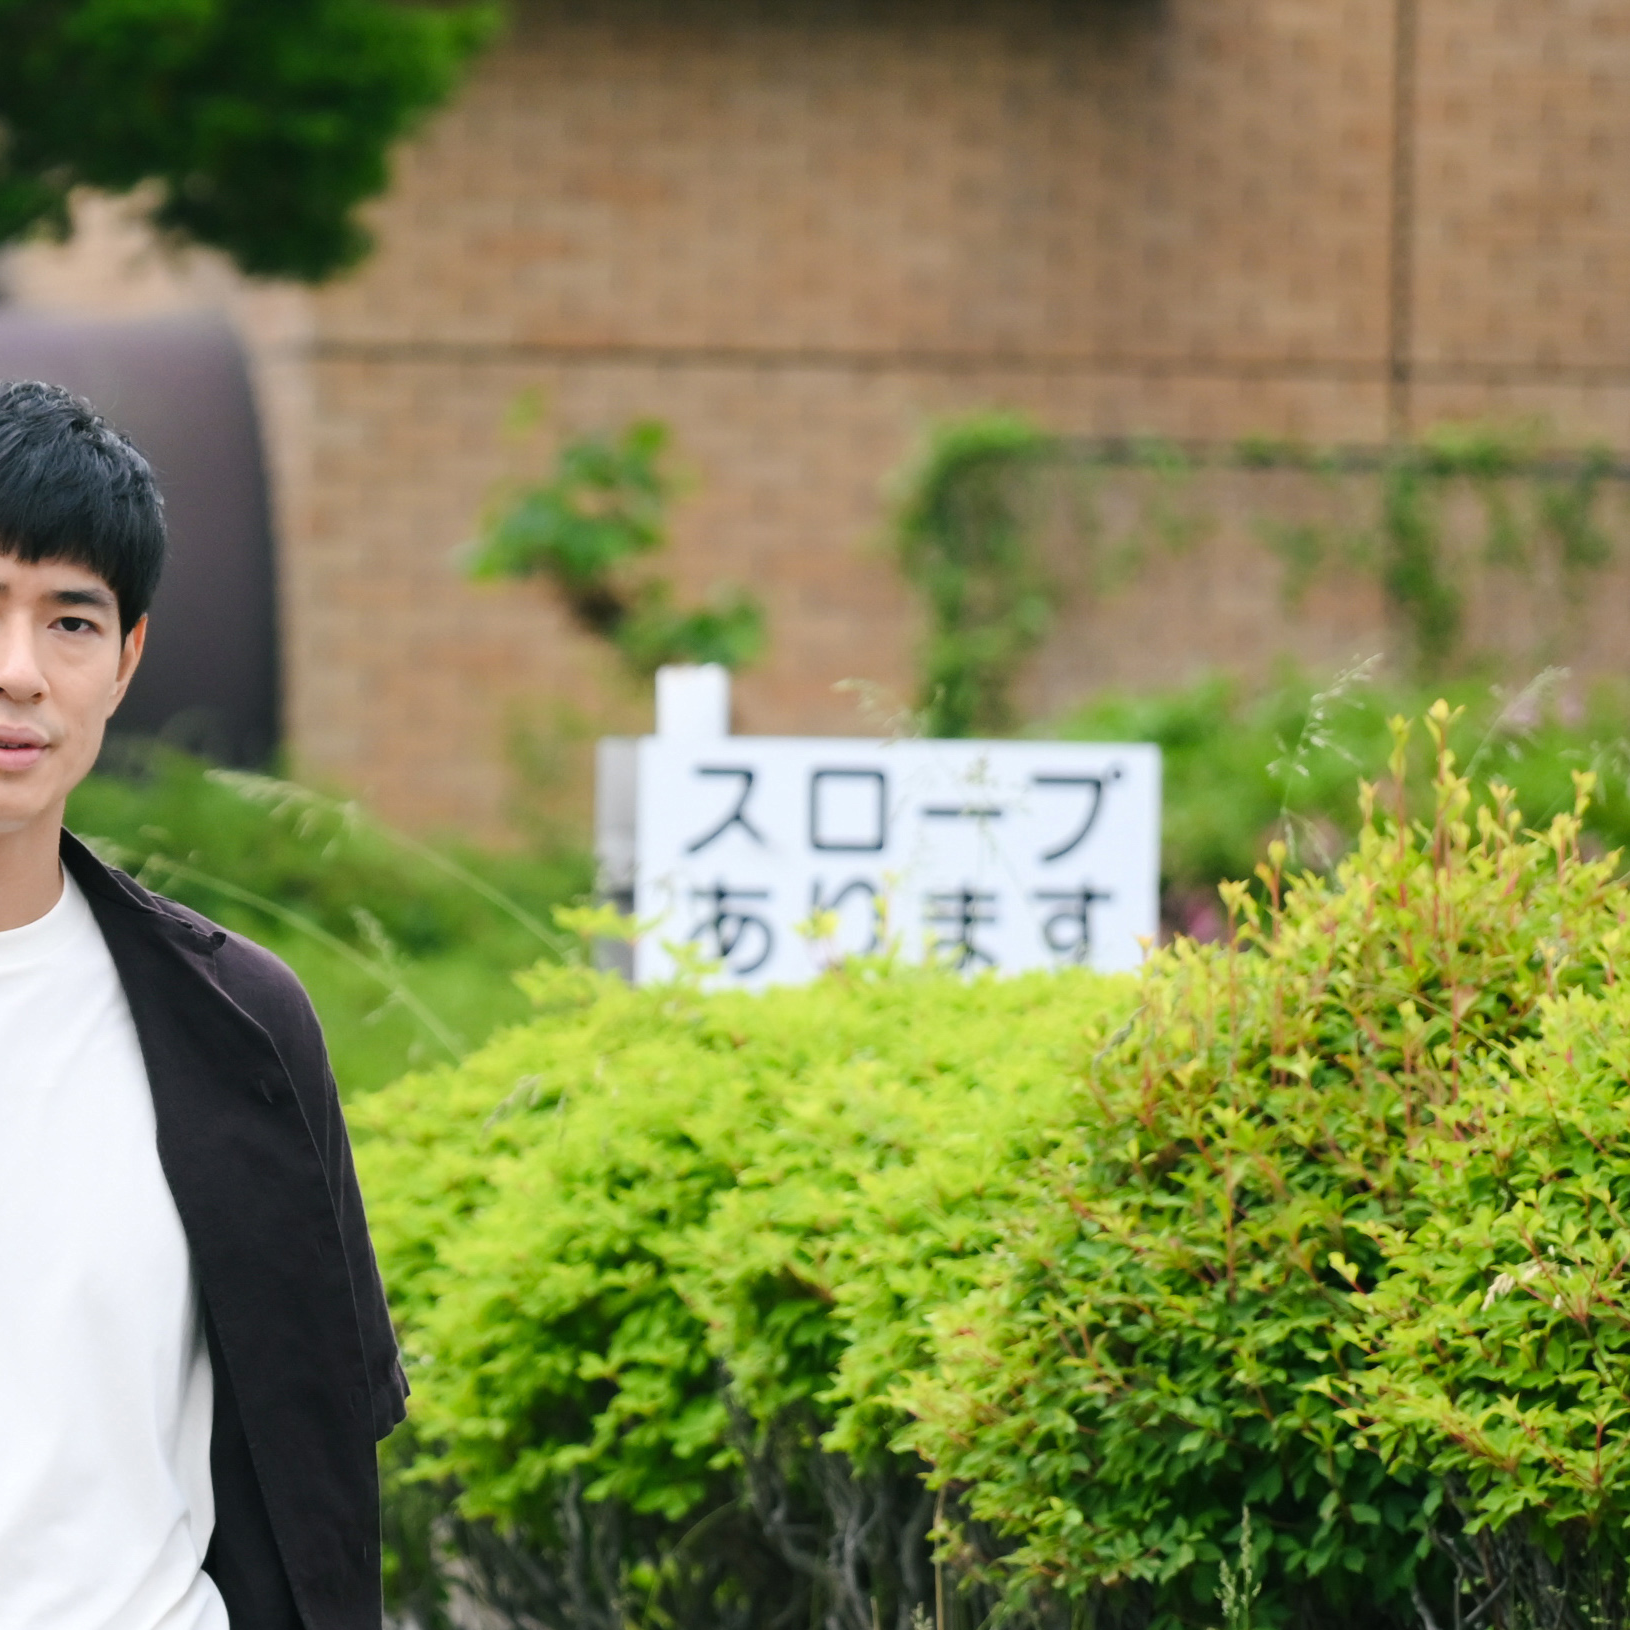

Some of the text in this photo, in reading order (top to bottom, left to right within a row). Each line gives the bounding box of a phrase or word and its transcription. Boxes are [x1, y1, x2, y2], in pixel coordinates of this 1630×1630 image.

[687, 766, 1126, 862] スロープ
[688, 877, 1113, 975] あります
